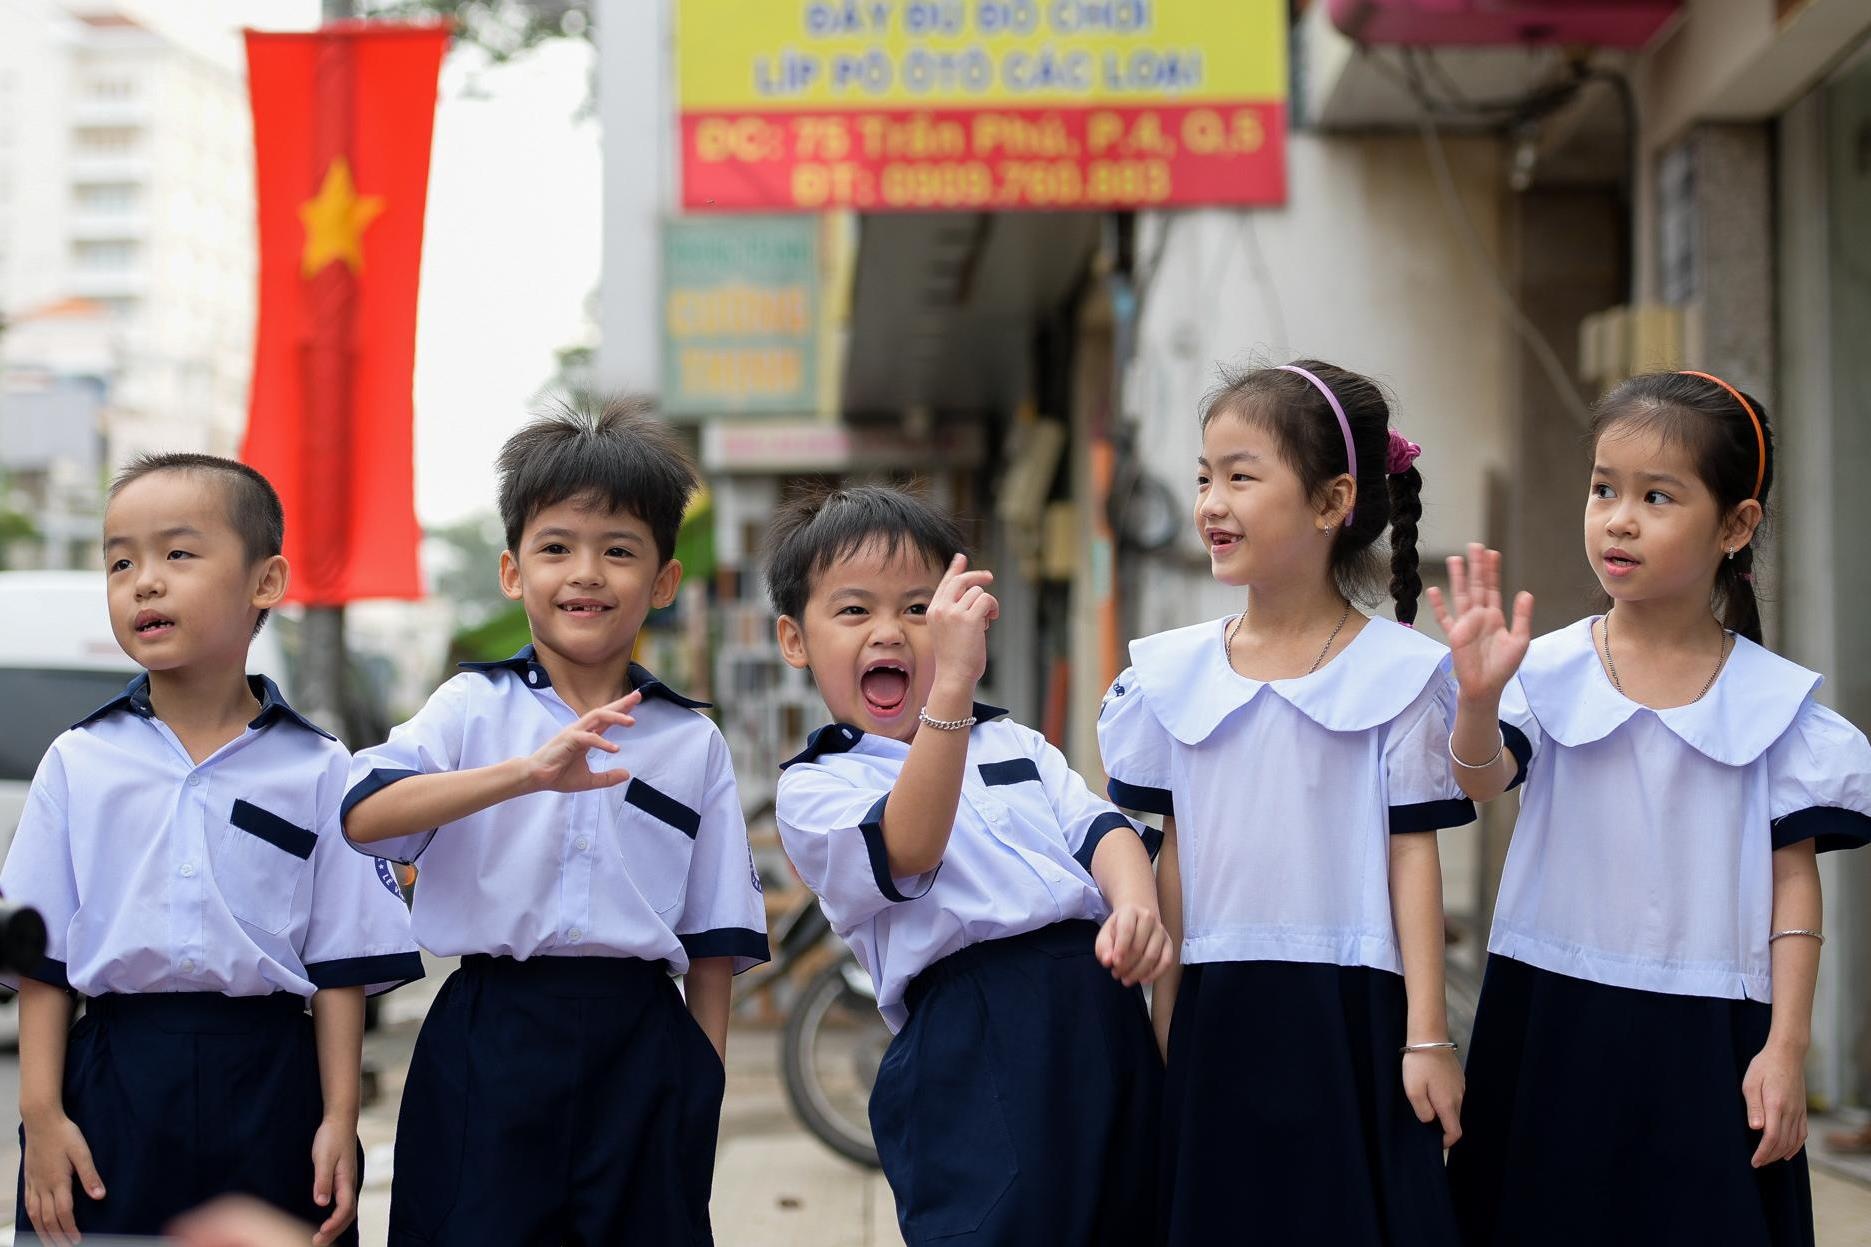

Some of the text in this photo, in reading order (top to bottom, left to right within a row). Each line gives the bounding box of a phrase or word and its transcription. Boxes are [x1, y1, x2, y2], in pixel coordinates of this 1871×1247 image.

[1002, 42, 1091, 92] CÁC
[1103, 48, 1203, 99] LOẠI
[793, 116, 849, 159] 75
[858, 110, 965, 158] Trần
